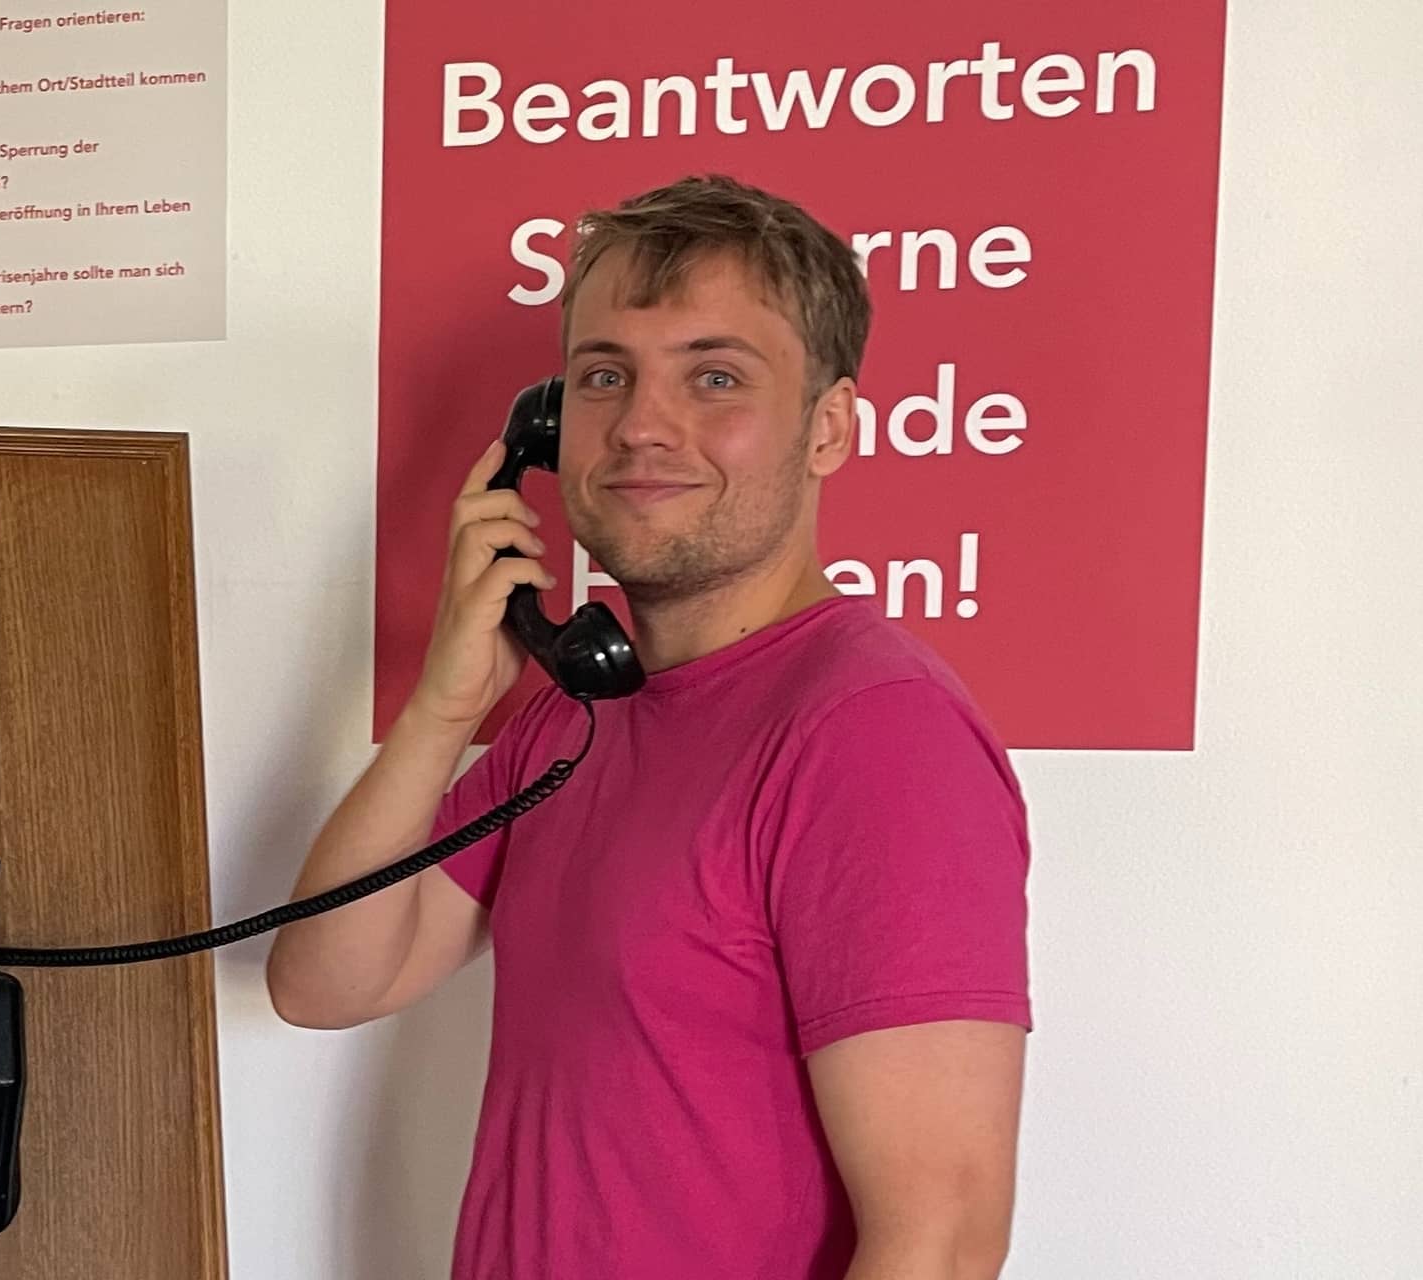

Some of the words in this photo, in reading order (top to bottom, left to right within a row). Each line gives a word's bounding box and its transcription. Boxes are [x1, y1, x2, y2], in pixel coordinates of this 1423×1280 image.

[0, 17, 51, 33] Fragen
[56, 10, 145, 27] orientieren:
[38, 72, 134, 92] Ort/Stadtteil
[140, 72, 206, 85] kommen
[441, 41, 1157, 147] Beantworten
[0, 144, 68, 160] Sperrung
[73, 140, 99, 153] der
[78, 204, 90, 216] in
[96, 202, 138, 216] Ihrem
[144, 199, 190, 213] Leben
[853, 225, 1033, 292] rne
[73, 266, 113, 280] sollte
[119, 268, 150, 277] man
[156, 262, 184, 276] sich
